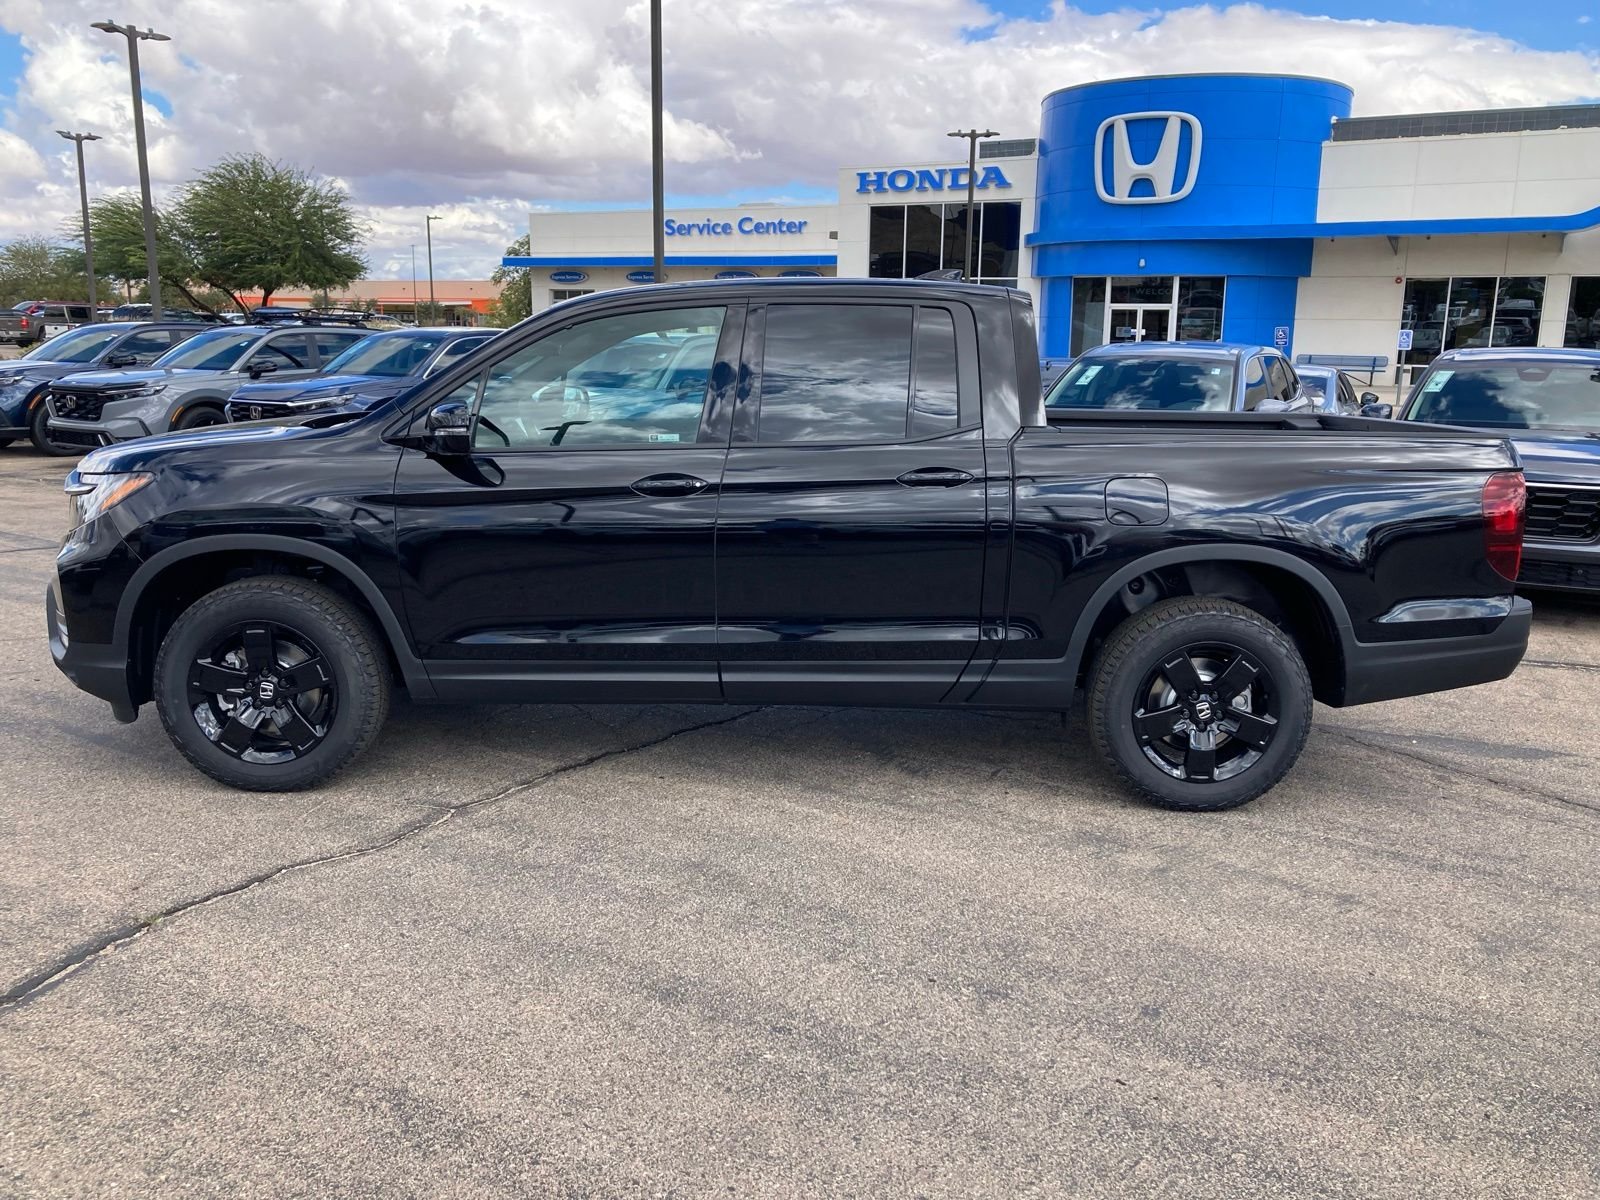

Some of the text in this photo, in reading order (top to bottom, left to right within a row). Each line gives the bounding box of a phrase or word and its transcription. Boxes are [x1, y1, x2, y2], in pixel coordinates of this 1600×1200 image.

[856, 166, 1012, 193] HONDA
[665, 217, 808, 236] Service Center
